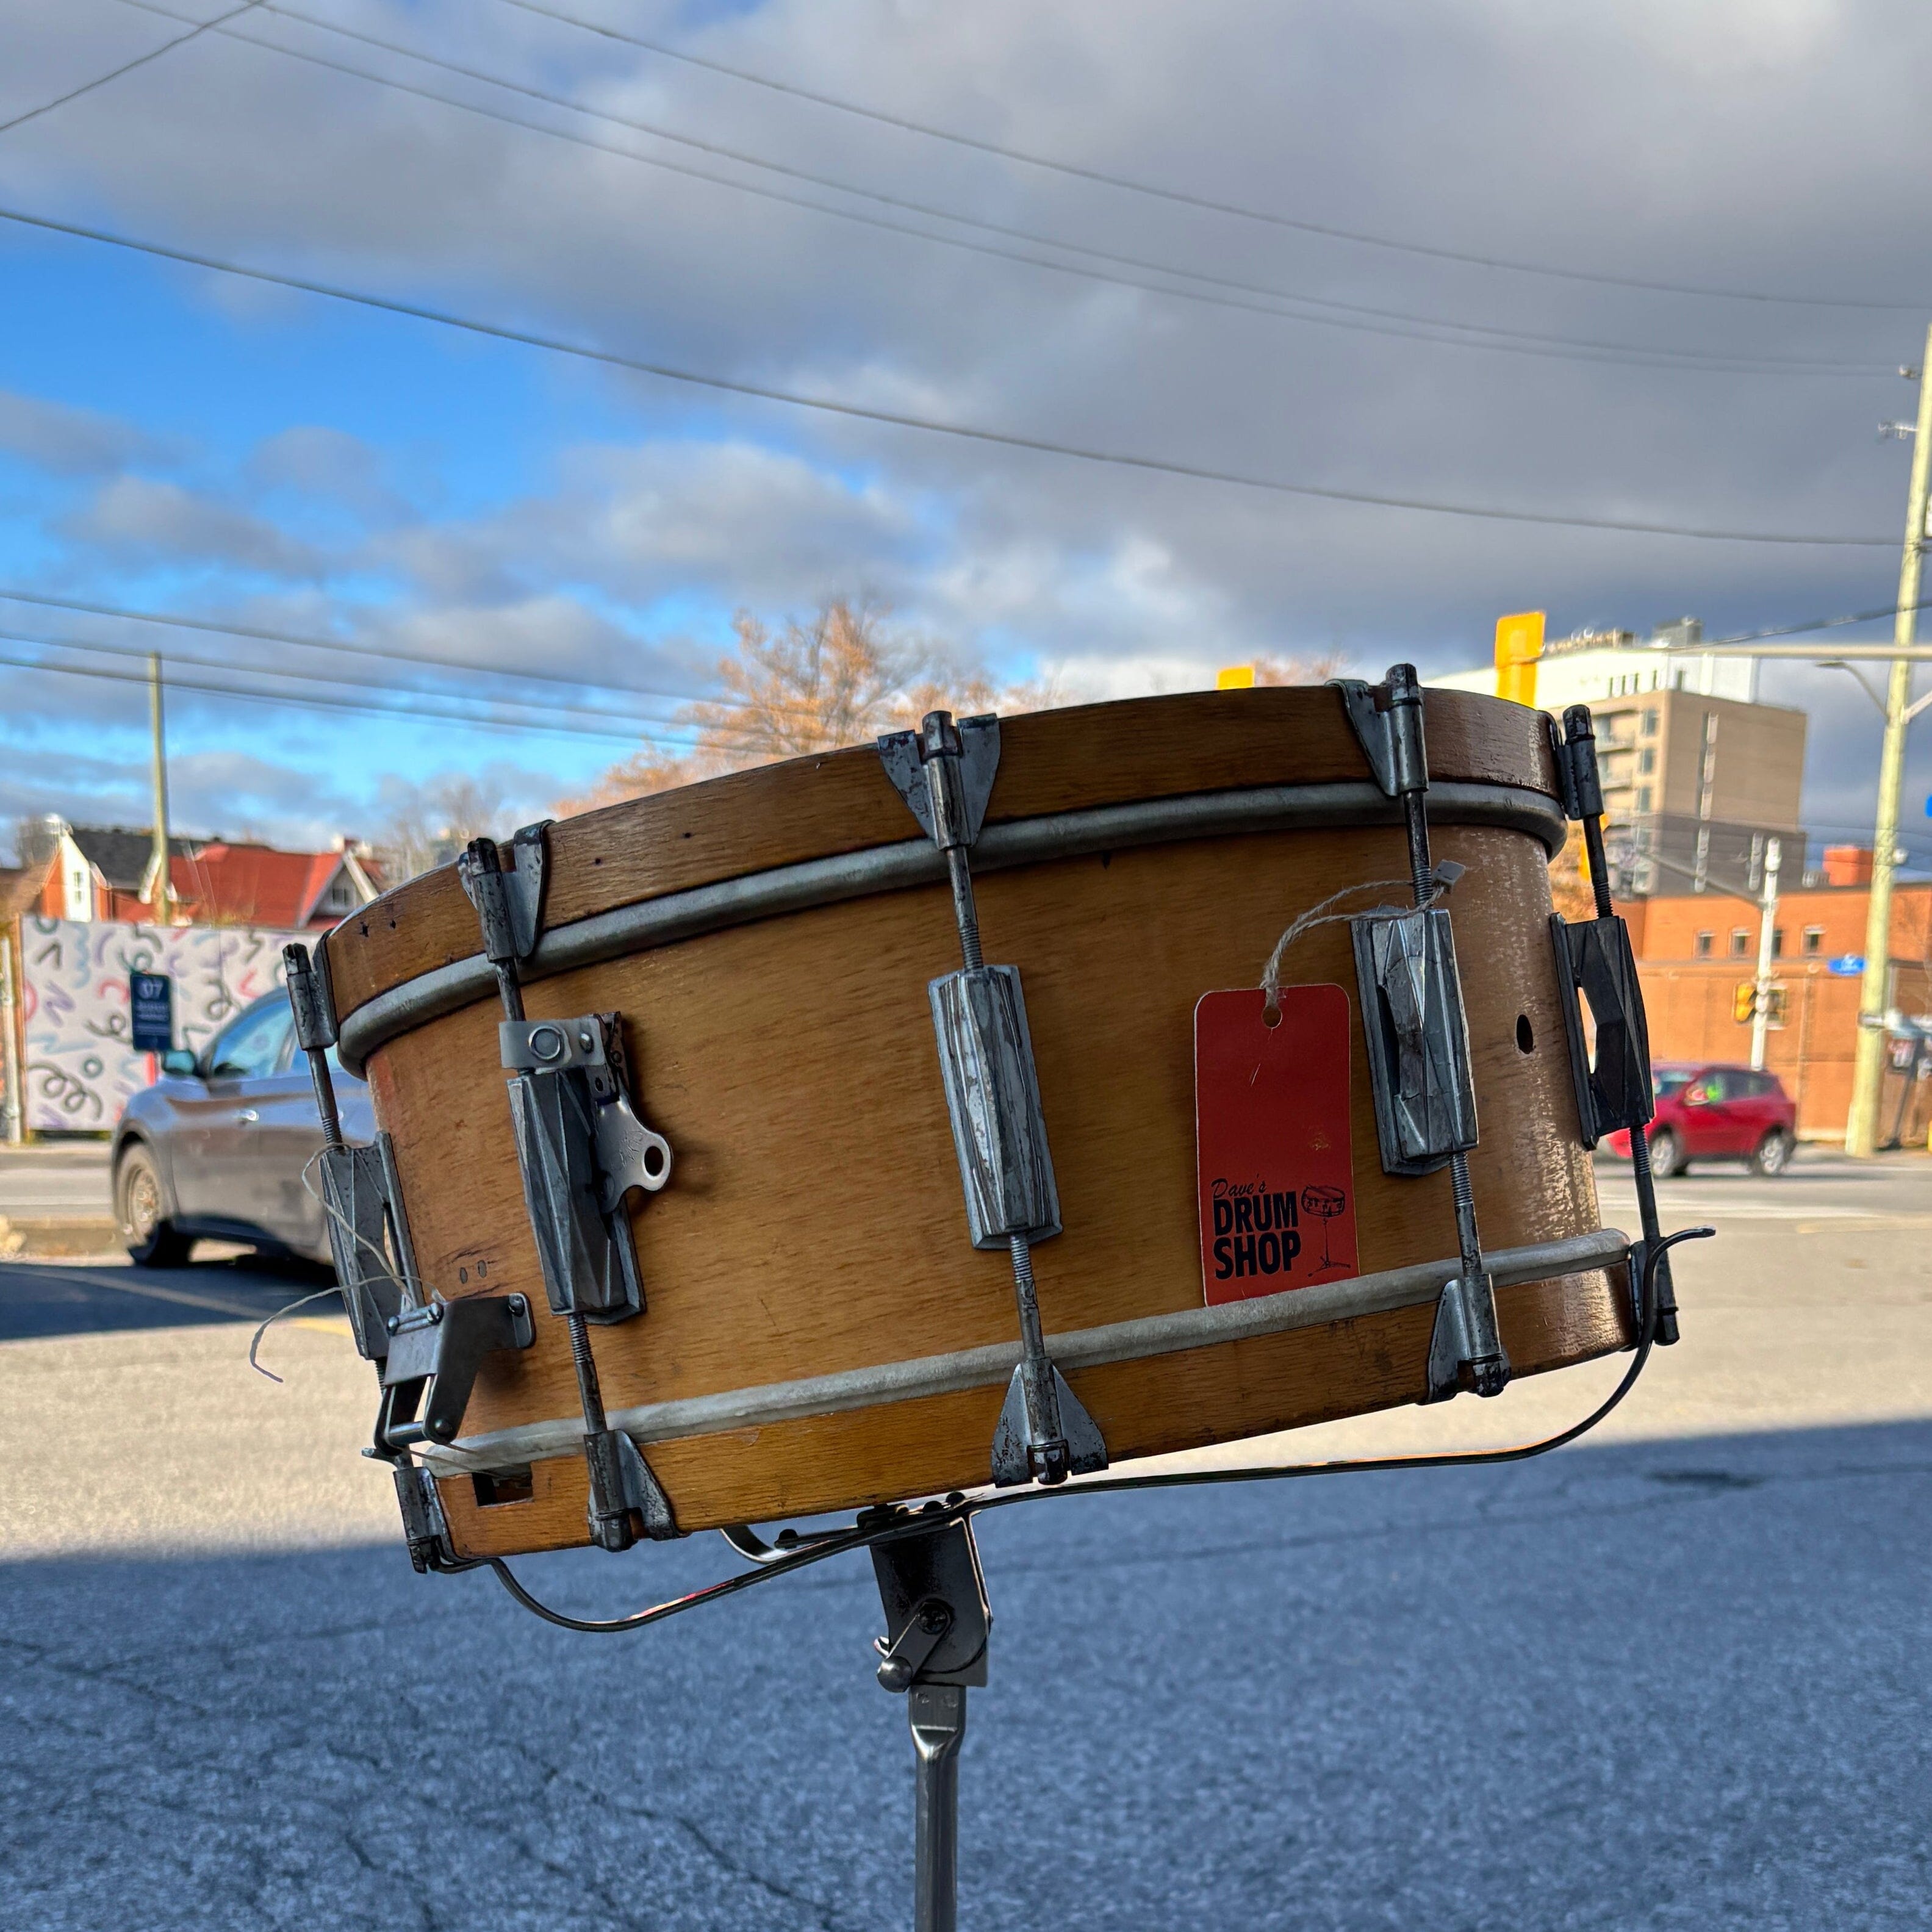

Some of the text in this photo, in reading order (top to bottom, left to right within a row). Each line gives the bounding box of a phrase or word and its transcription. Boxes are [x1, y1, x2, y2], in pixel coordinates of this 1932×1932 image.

[1211, 1173, 1266, 1199] Dave's
[1213, 1191, 1298, 1236] DRUM
[1213, 1230, 1301, 1279] SHOP
